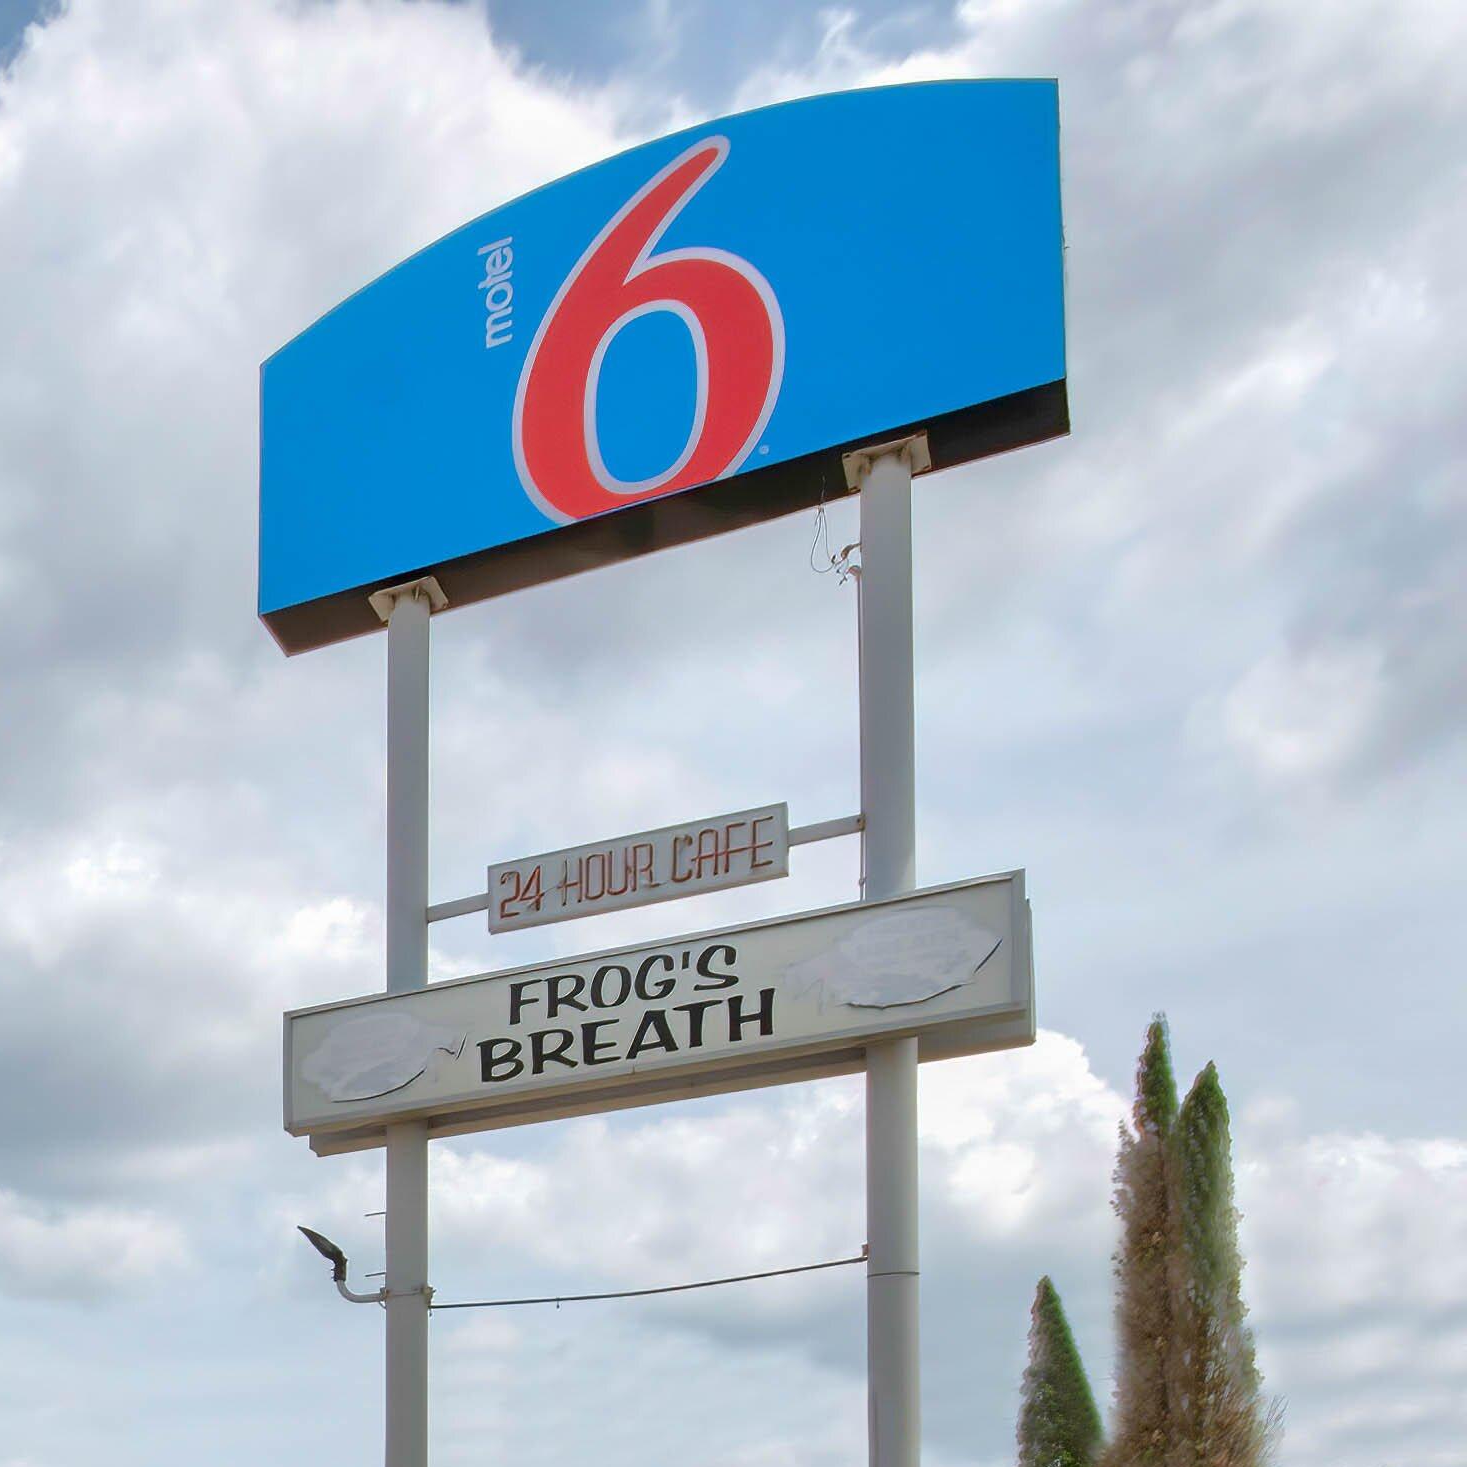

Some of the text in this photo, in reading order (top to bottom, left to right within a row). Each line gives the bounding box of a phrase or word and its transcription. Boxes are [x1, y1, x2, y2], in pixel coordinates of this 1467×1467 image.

[477, 236, 513, 349] motel
[512, 134, 786, 525] 6
[500, 815, 774, 919] 24 HOUR CAFE
[476, 987, 776, 1083] BREATH
[509, 944, 739, 1025] FROG'S
